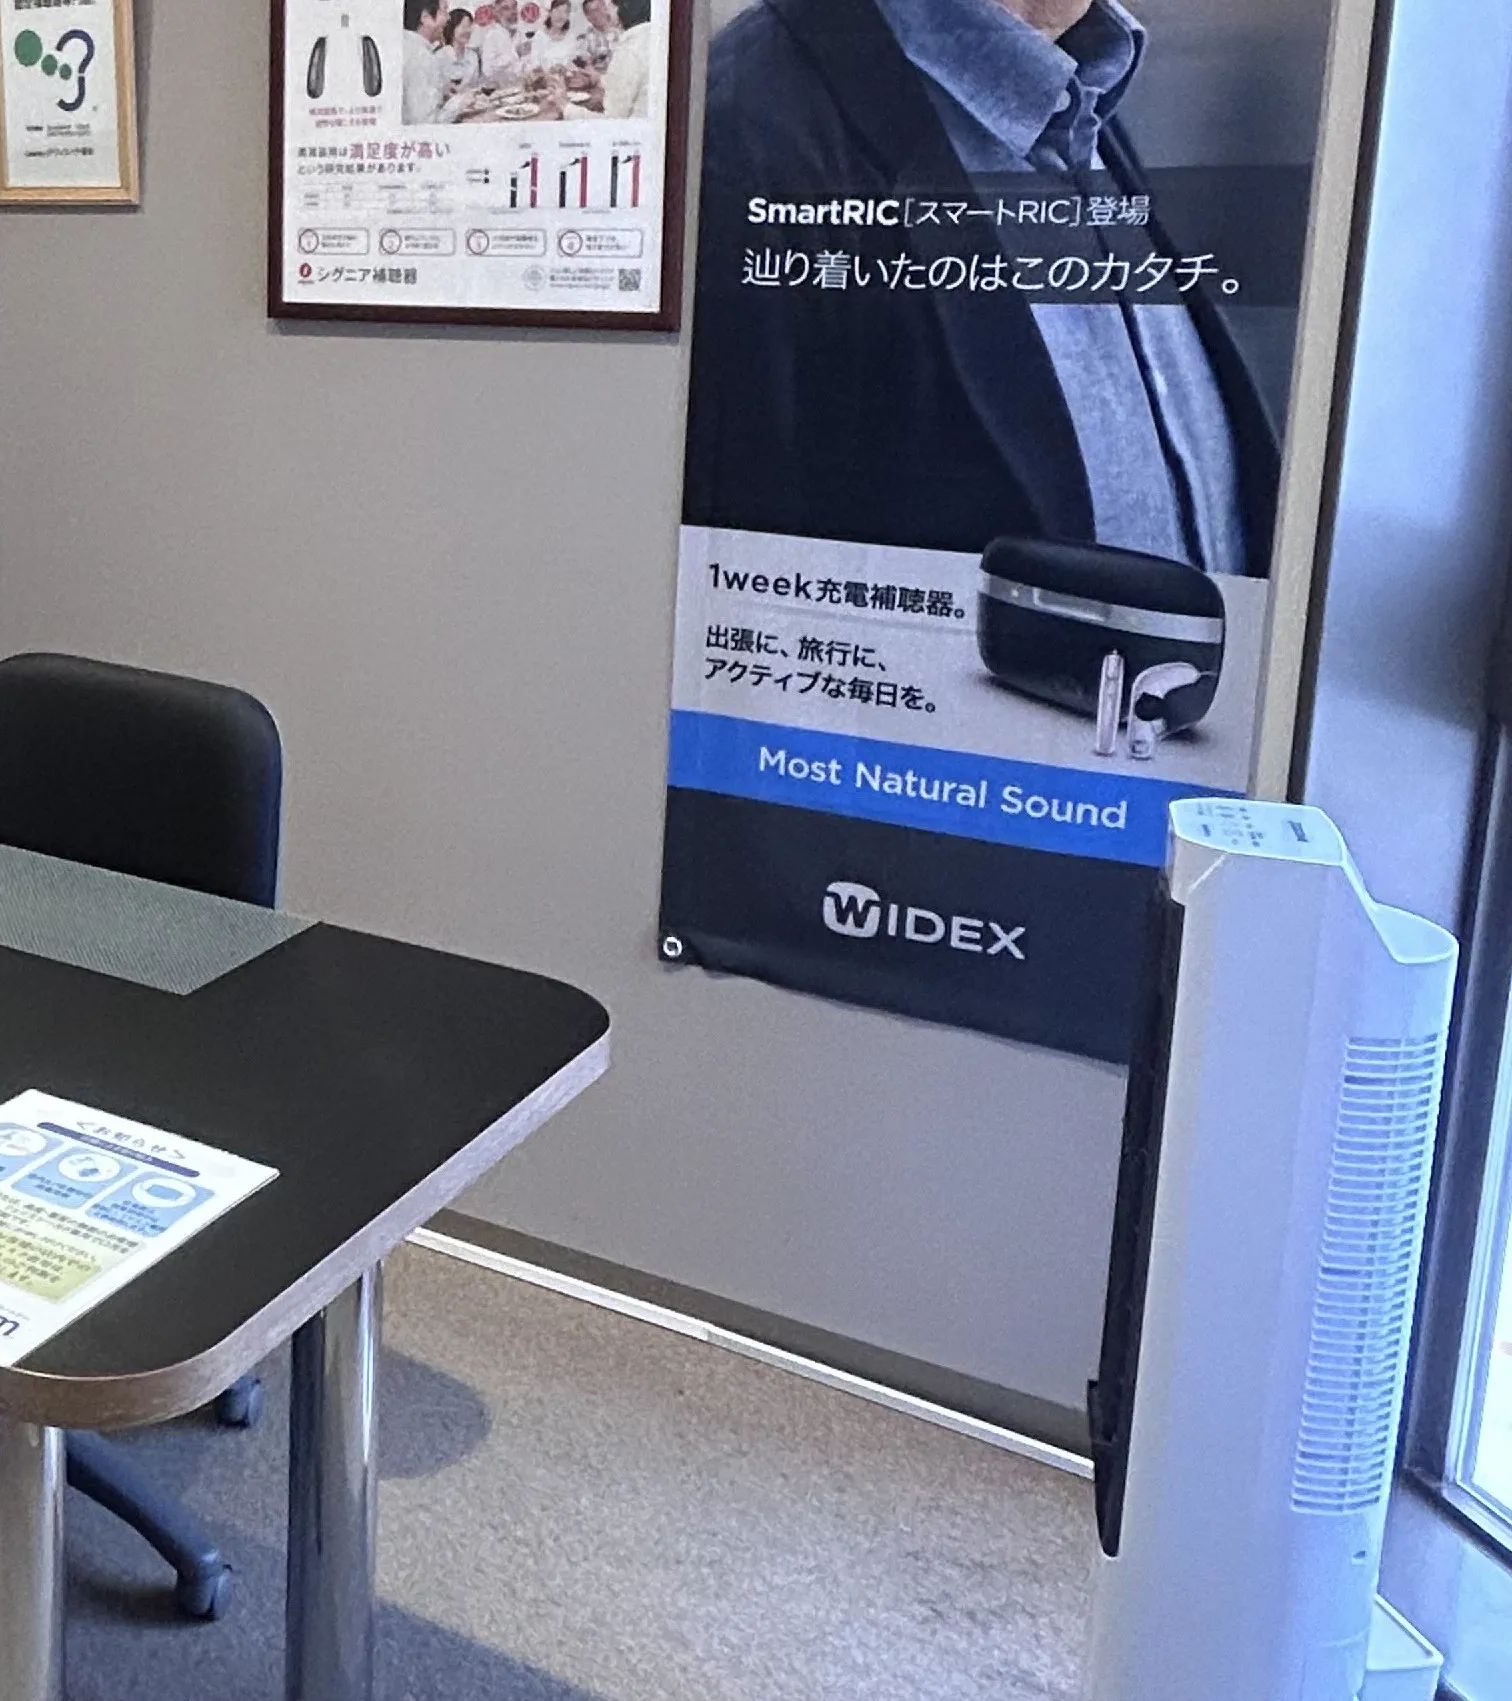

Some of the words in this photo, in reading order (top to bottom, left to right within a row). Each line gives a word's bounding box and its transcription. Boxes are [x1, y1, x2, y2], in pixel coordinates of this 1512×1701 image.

[742, 247, 1240, 295] 辿り着いたのはこのカタチ。
[708, 562, 966, 619] 1week充電補聴器。
[705, 624, 888, 672] 出張に、旅行に、
[704, 658, 937, 713] アクティブな毎日を。
[759, 746, 841, 784] Most
[855, 762, 989, 808] Natural
[1000, 786, 1127, 829] Sound
[823, 881, 1026, 960] WIDEX
